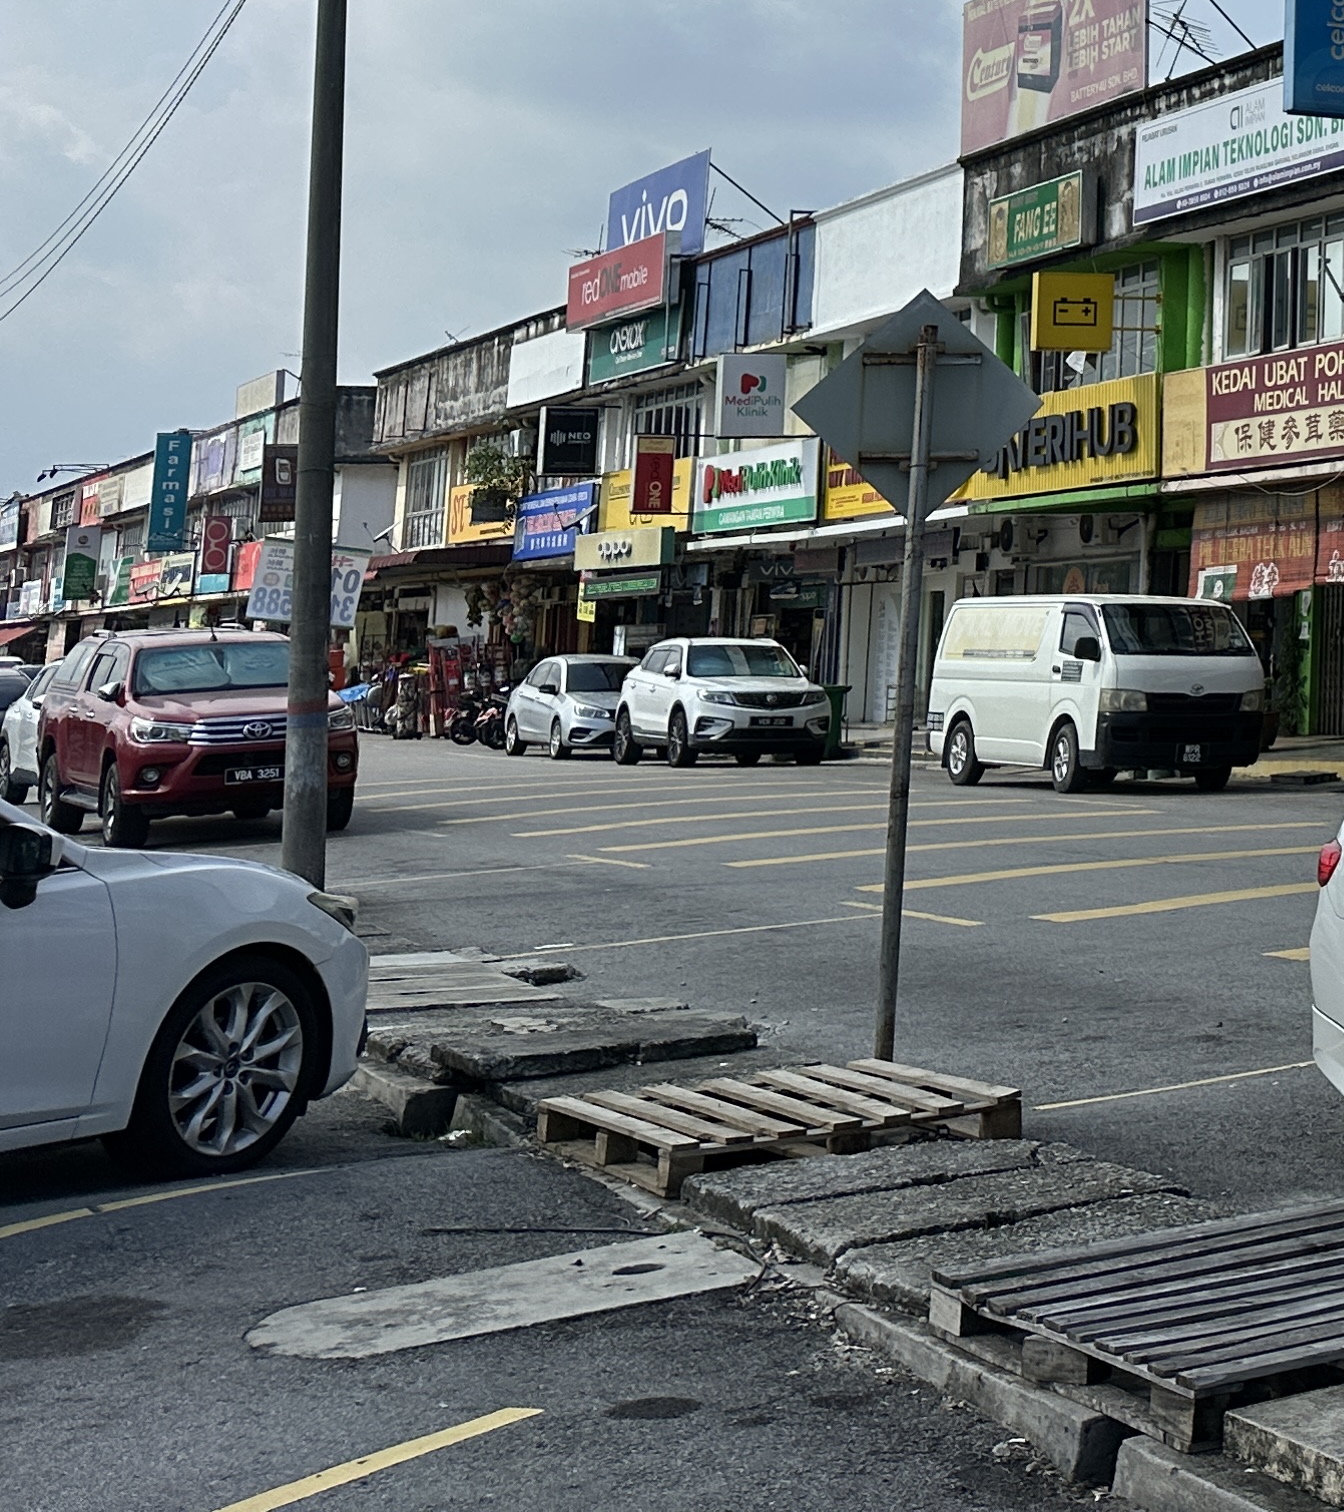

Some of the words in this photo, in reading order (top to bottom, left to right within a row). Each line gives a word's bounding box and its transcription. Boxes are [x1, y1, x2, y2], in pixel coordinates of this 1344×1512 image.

[1067, 24, 1099, 53] LEBIH
[1102, 6, 1141, 32] TAHAN
[1066, 44, 1099, 72] LEBIH
[1101, 29, 1138, 60] START
[1144, 160, 1176, 191] ALAM
[1178, 143, 1219, 179] IMPIAN
[1222, 122, 1294, 168] TEKNOLOGI
[1297, 116, 1327, 145] SDN.
[621, 188, 688, 245] vivo
[1014, 207, 1041, 244] FANG
[620, 265, 648, 292] mobile
[1212, 365, 1256, 396] KEDAI
[1264, 357, 1308, 387] UBAT
[725, 396, 781, 407] MediPulih
[736, 406, 768, 417] Klinik
[1254, 387, 1309, 413] MEDICAL
[568, 431, 591, 440] NEO
[162, 440, 180, 529] Farmasi
[598, 541, 632, 561] oppo
[760, 562, 795, 576] viv
[234, 769, 252, 780] VBA
[257, 767, 280, 779] 3251
